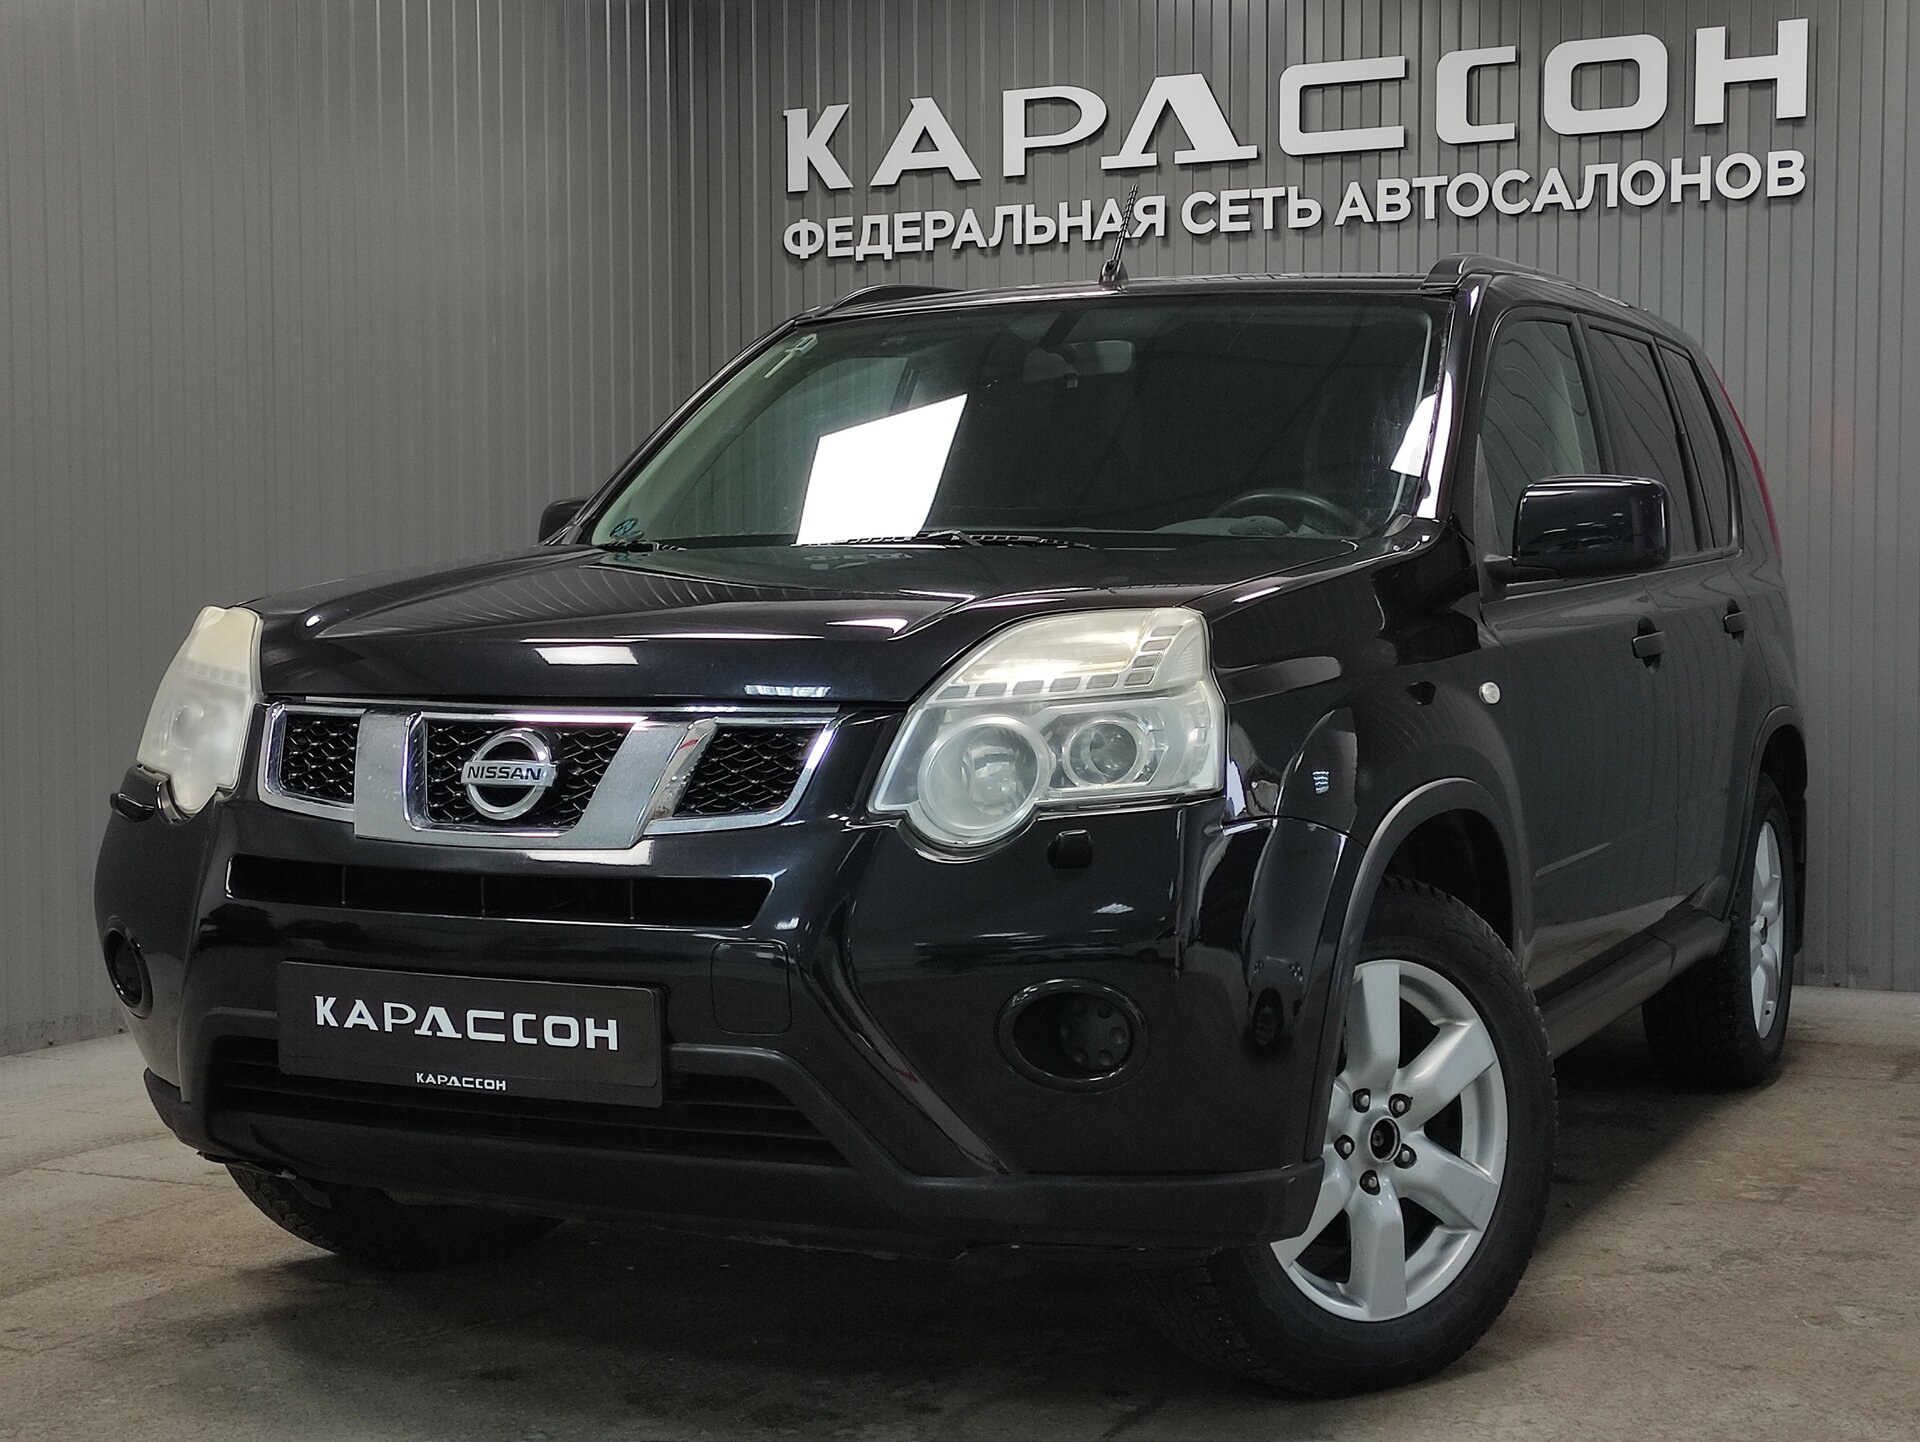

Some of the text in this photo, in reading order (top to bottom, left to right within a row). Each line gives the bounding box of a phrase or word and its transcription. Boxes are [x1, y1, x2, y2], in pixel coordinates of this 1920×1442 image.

[783, 150, 1807, 261] ФЕДЕРАЛЬНАЯ СЕТЬ АВТОСАЛОНОВ
[467, 766, 542, 781] NISSAN
